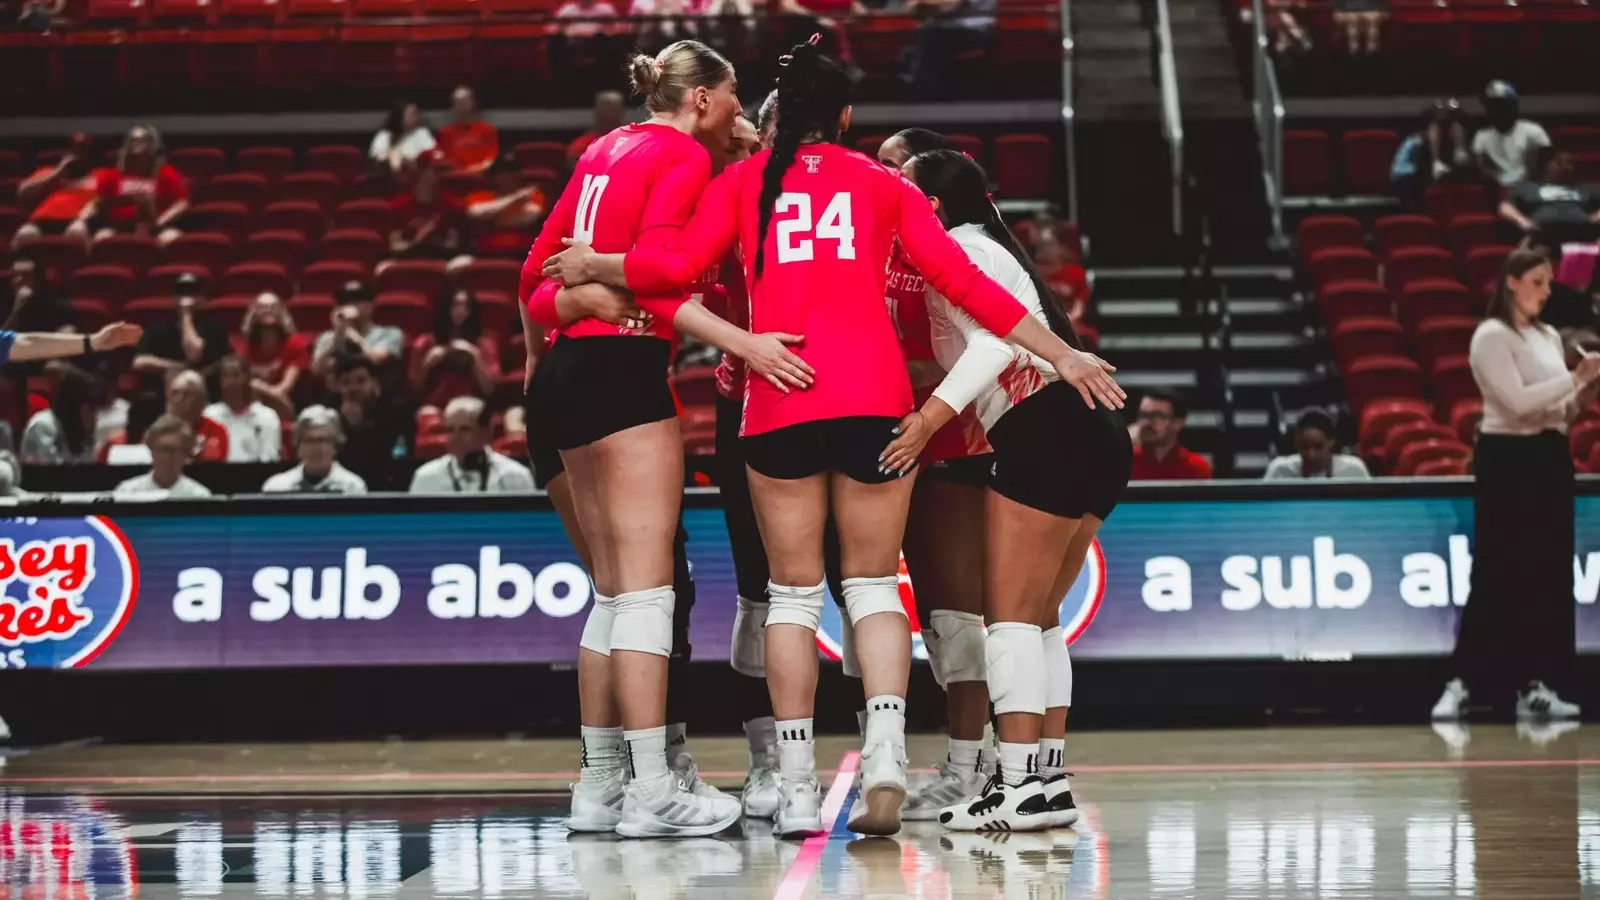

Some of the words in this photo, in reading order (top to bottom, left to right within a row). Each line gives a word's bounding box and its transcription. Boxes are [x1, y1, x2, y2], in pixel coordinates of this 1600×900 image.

[573, 173, 610, 245] 10
[775, 192, 856, 264] 24
[173, 567, 223, 622] a
[249, 547, 401, 622] sub
[426, 545, 591, 619] abo
[1141, 556, 1193, 612] a
[1221, 536, 1373, 611] sub
